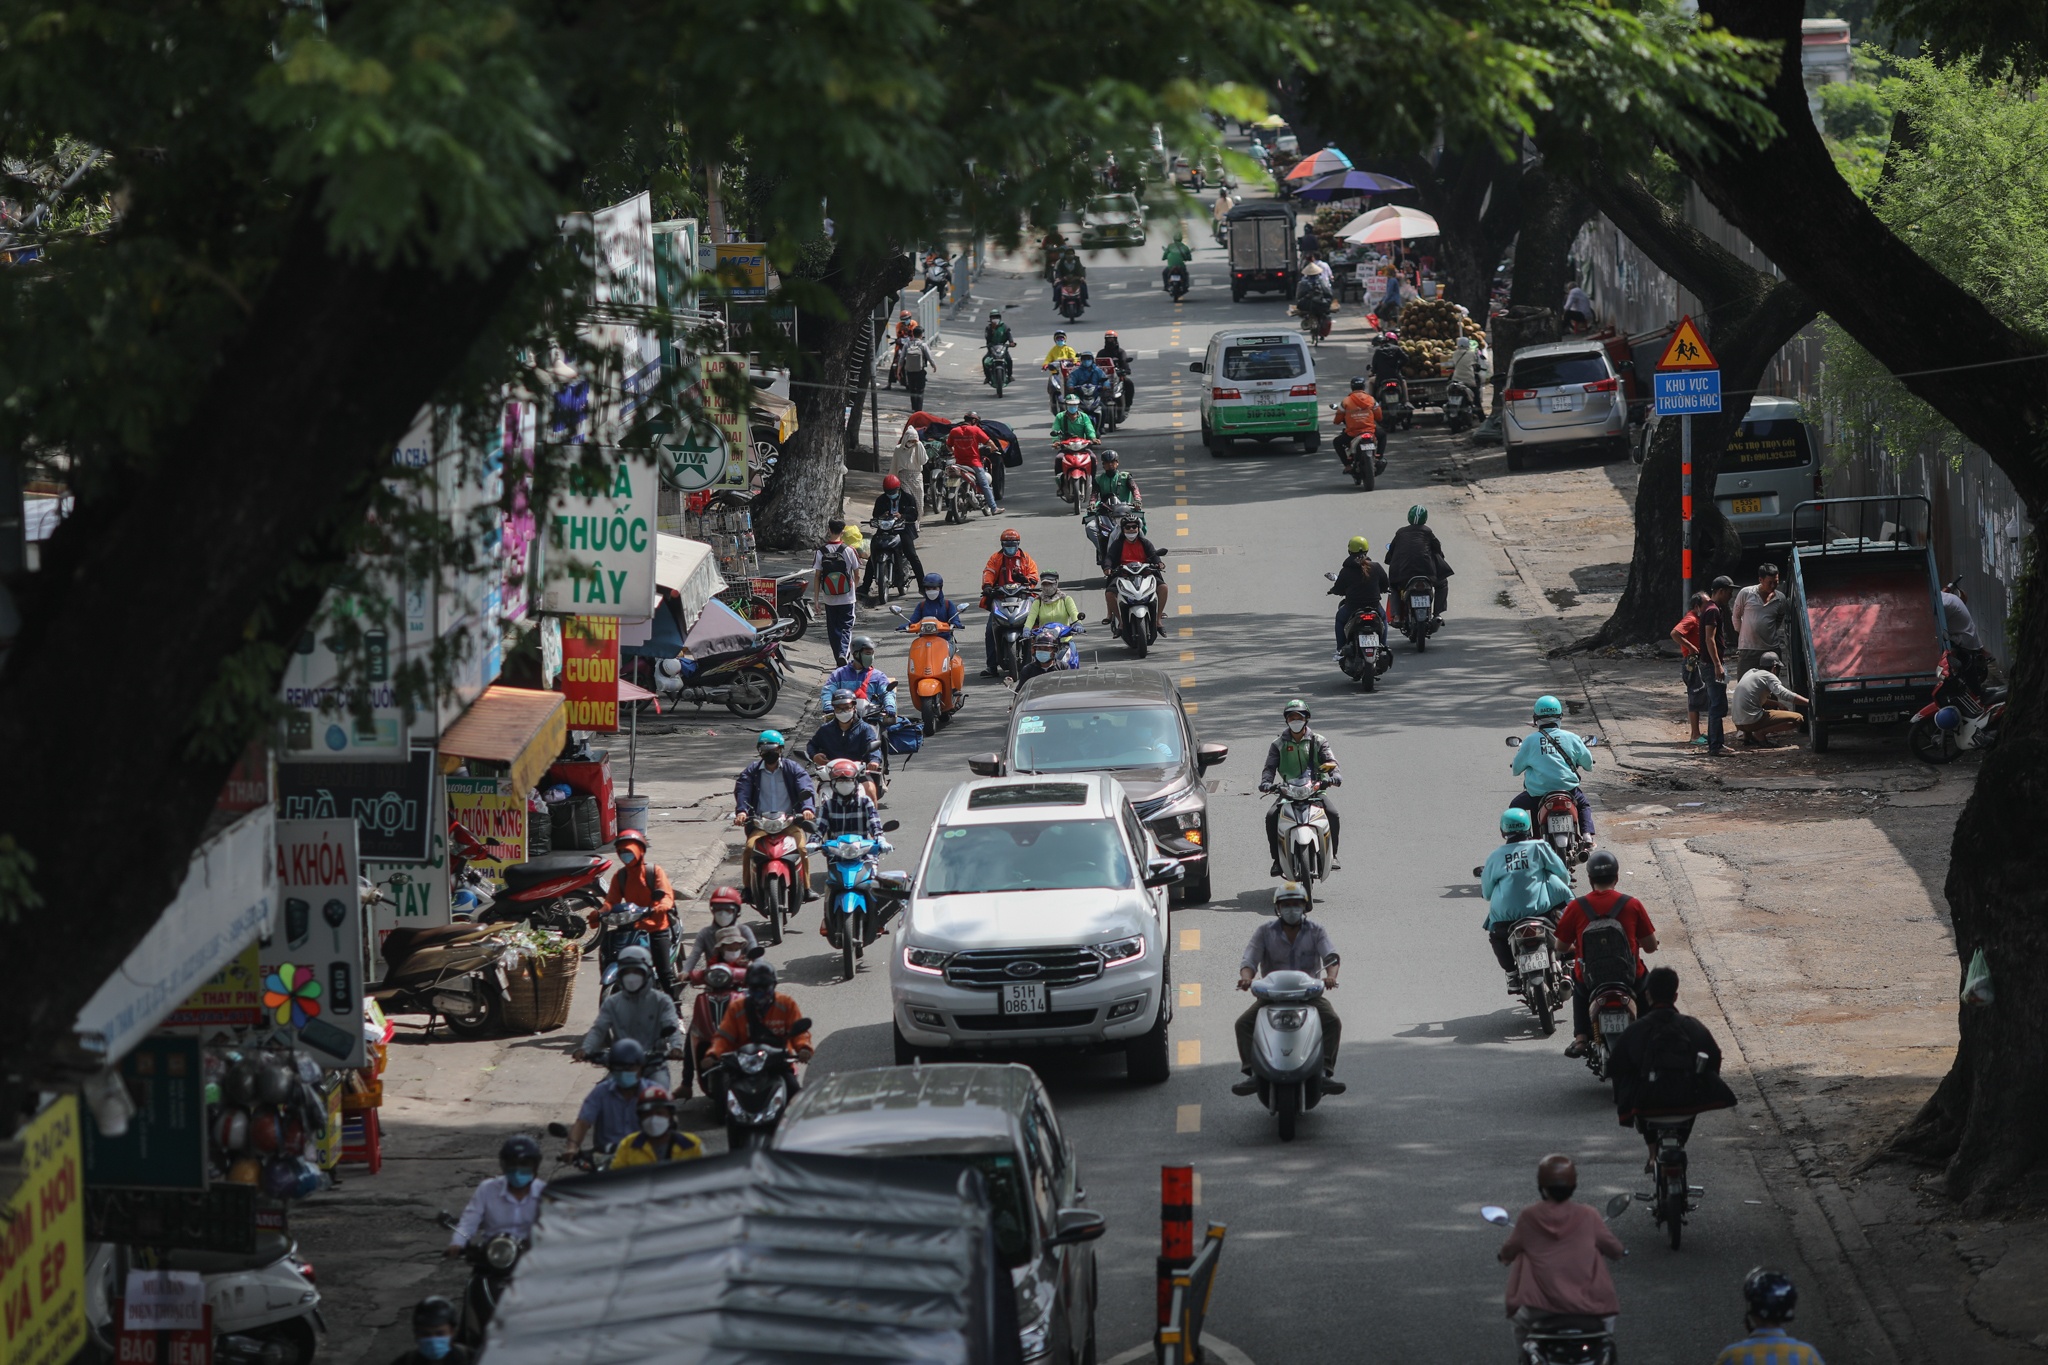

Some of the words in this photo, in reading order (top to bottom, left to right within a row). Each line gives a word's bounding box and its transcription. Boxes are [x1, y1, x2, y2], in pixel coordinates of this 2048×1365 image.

[706, 361, 746, 374] LAPOP
[1666, 379, 1686, 392] KHU
[1690, 377, 1709, 392] VỰC
[1659, 392, 1698, 410] TRƯỜNG
[1700, 393, 1718, 409] HỌC
[673, 452, 709, 465] VIVA
[553, 503, 648, 553] THUỐC
[568, 560, 628, 605] TÂY
[565, 650, 616, 684] CUỐN
[565, 696, 616, 727] NÓNG
[446, 784, 473, 795] ương
[475, 782, 494, 794] Lan
[351, 791, 418, 837] NỘI
[292, 831, 348, 886] KHÓA
[1505, 849, 1528, 864] BAE
[1506, 859, 1530, 872] MIN
[391, 875, 431, 917] TÂY
[1013, 985, 1035, 999] 51H
[1005, 998, 1045, 1013] 086.14
